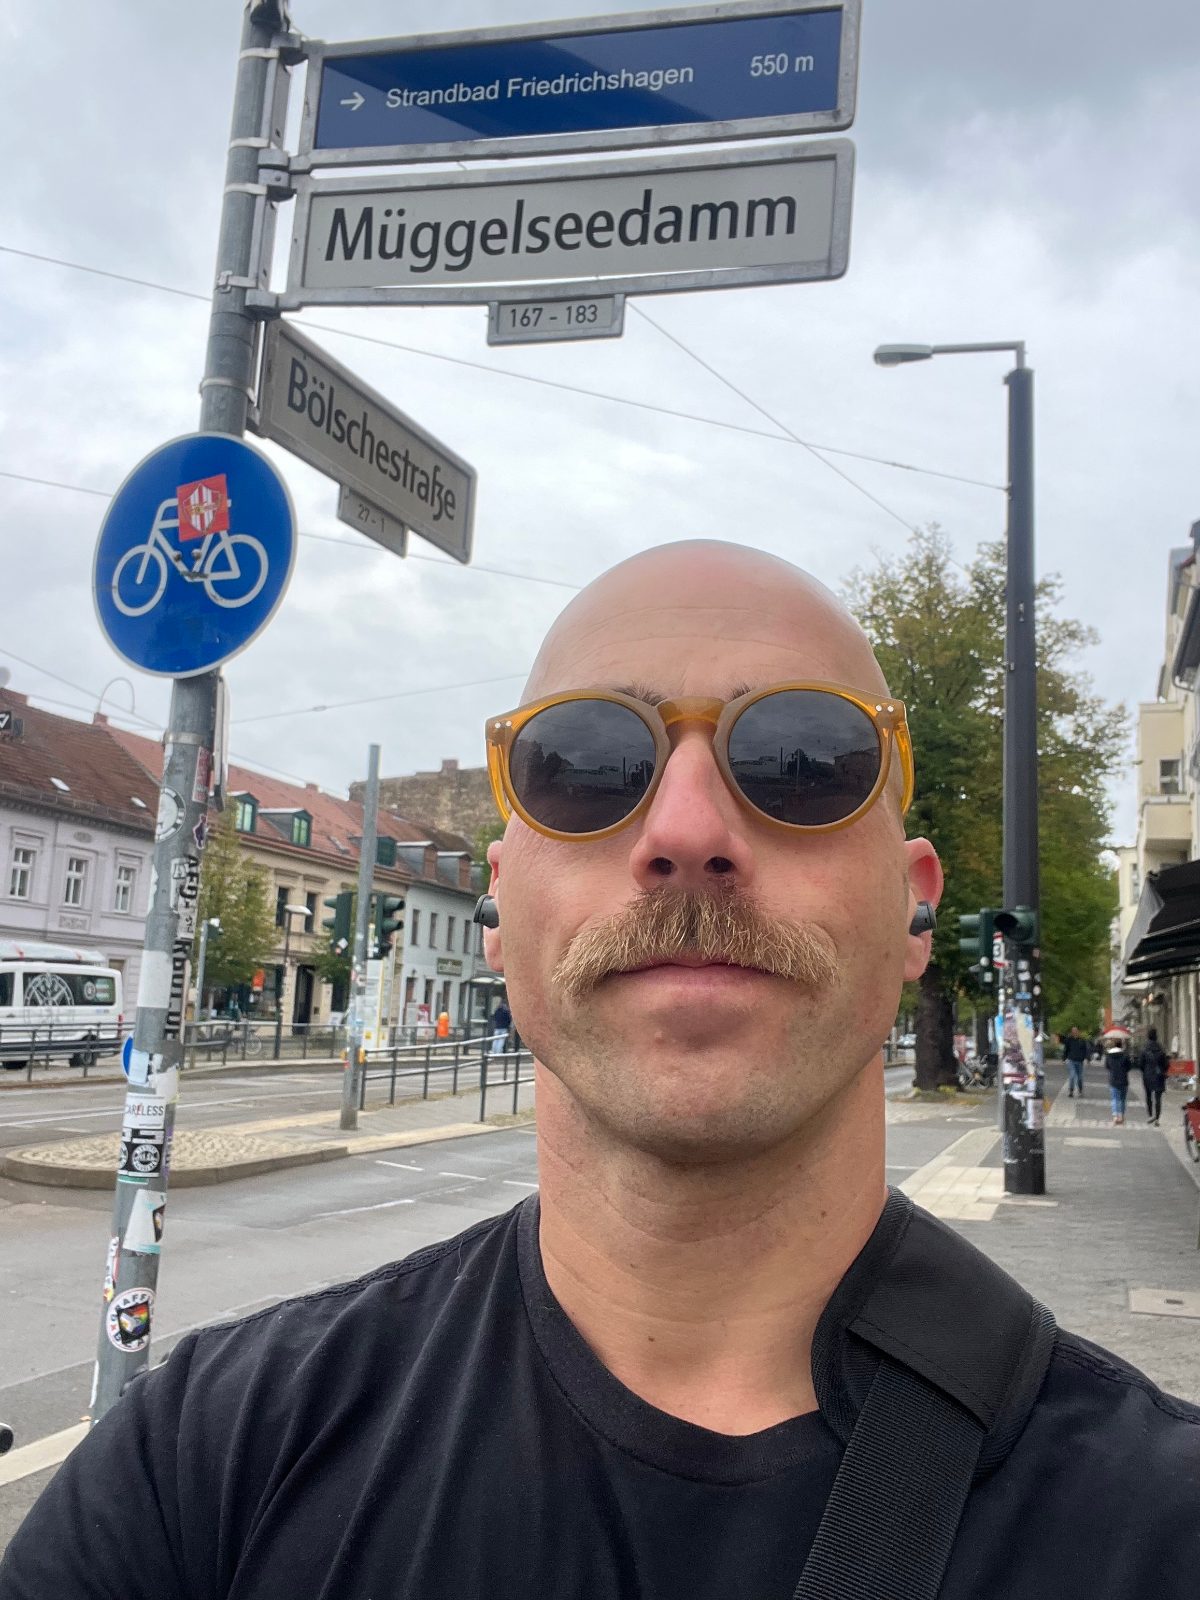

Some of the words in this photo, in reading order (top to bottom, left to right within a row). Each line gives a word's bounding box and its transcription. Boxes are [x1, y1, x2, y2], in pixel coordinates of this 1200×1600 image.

[385, 80, 499, 109] Strandbad
[506, 66, 695, 98] Friedrichshagen
[750, 53, 788, 77] 550
[794, 55, 814, 73] m
[324, 189, 798, 273] Müggelseedamm
[510, 307, 543, 328] 167
[566, 304, 598, 325] 183
[287, 357, 456, 522] Bölschestraße
[358, 503, 370, 523] 27
